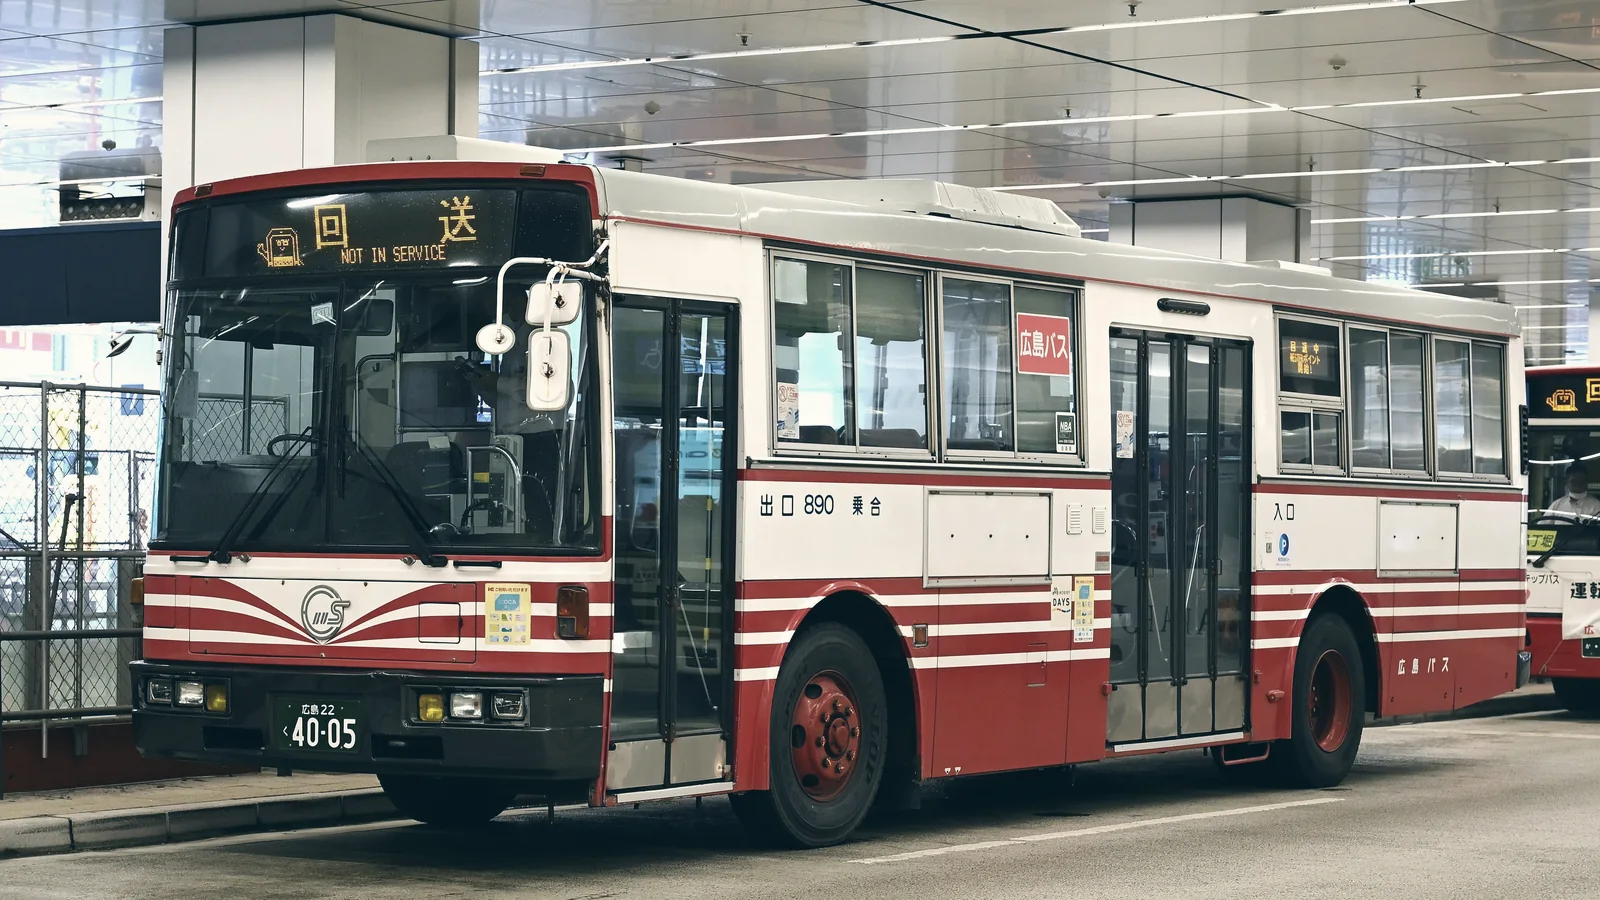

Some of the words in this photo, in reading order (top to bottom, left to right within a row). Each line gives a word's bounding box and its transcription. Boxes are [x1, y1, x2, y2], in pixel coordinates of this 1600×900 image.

[314, 195, 477, 250] 回送
[341, 248, 364, 264] NOT
[372, 247, 387, 263] IN
[393, 244, 447, 262] SERVICE
[1020, 329, 1068, 359] 広島バス
[760, 494, 794, 517] 出口
[804, 494, 834, 515] 890
[852, 496, 881, 517] 乗合
[1273, 502, 1295, 521] 入口
[1052, 598, 1071, 607] DAYS
[1397, 656, 1450, 675] 広島バス
[301, 704, 319, 715] 広島
[320, 704, 335, 716] 22
[282, 726, 288, 737] く
[292, 716, 357, 749] 40-05
